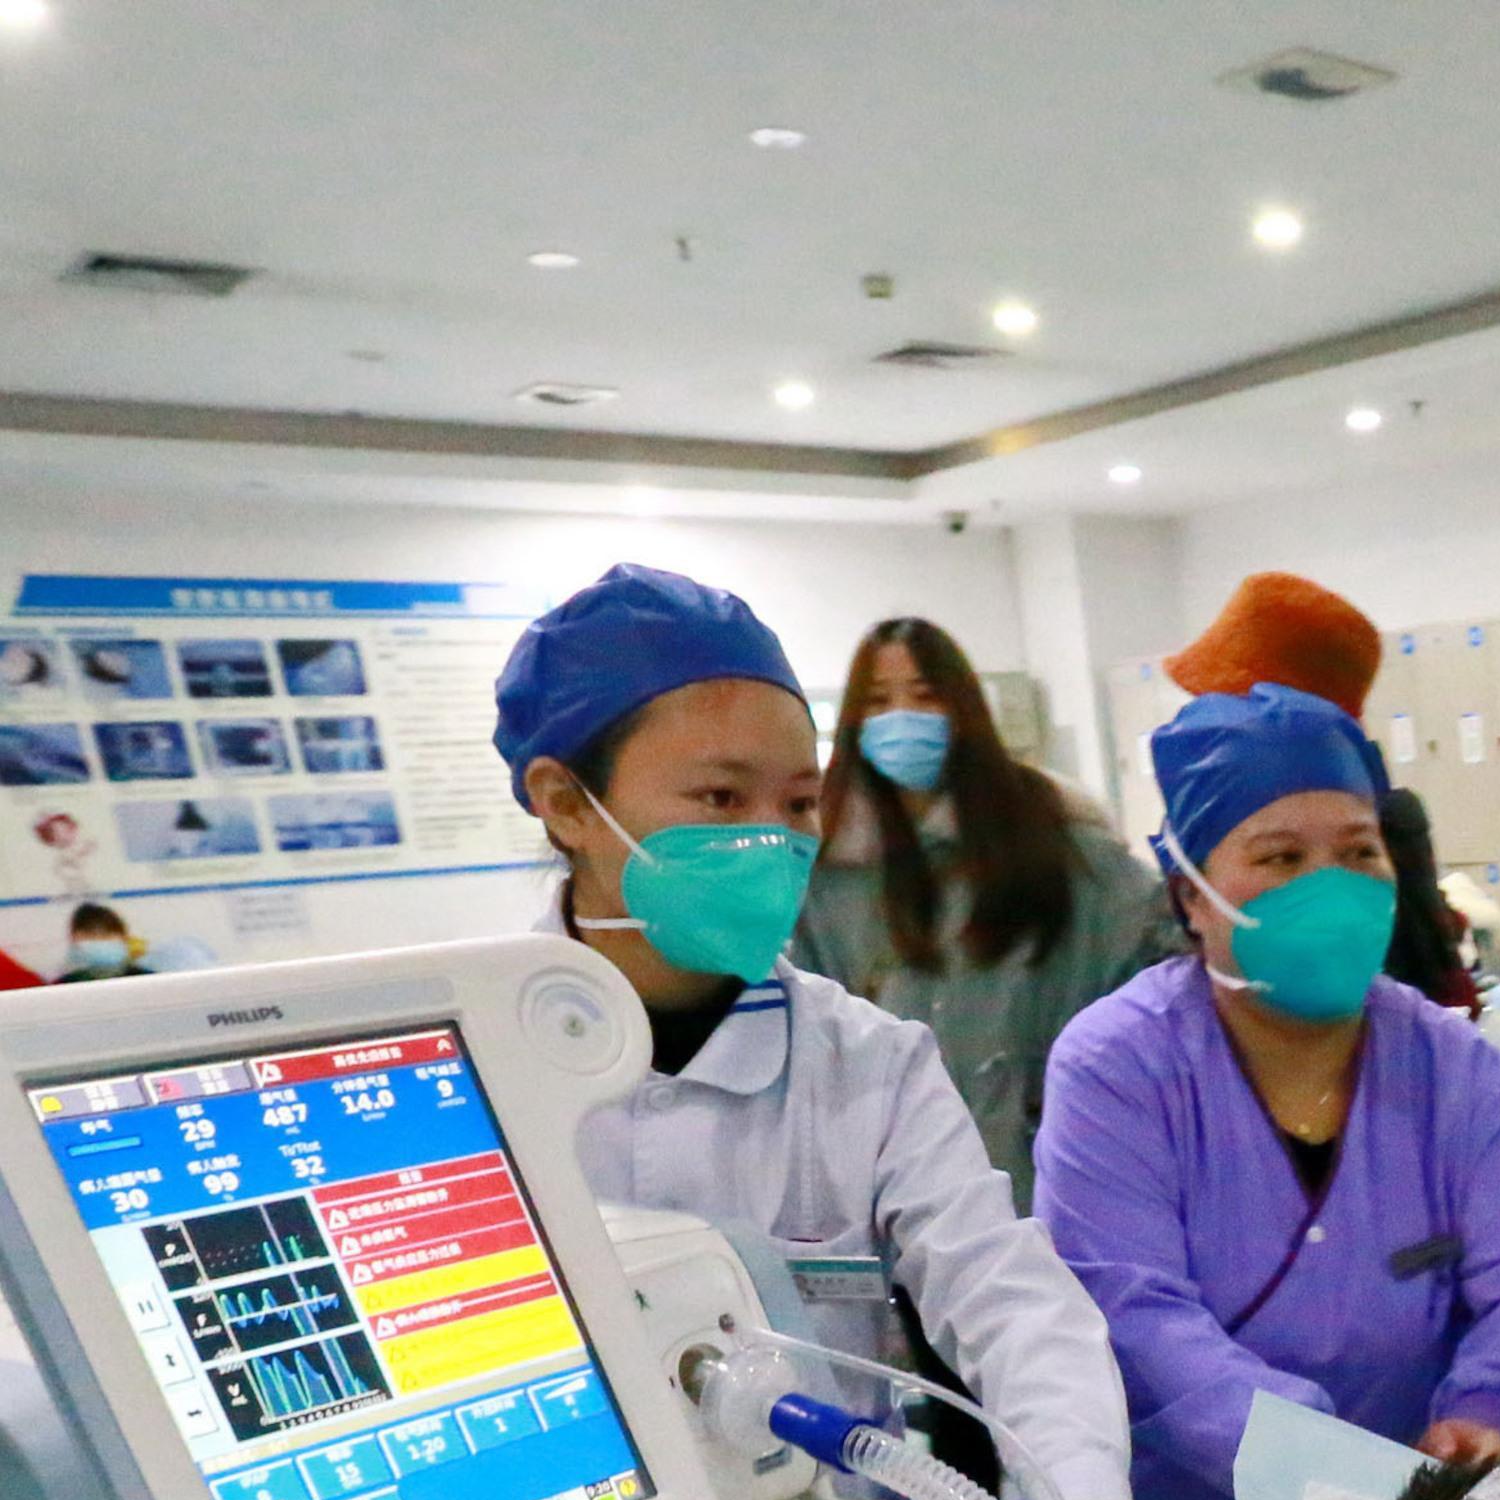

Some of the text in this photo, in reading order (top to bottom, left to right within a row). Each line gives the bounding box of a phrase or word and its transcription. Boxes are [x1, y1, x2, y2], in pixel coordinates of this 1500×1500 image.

[207, 1006, 283, 1027] PHILIPS
[437, 1079, 454, 1098] 9
[340, 1089, 395, 1115] 14.0
[263, 1103, 307, 1127] 487
[179, 1119, 216, 1142] 29
[291, 1155, 326, 1179] 32
[203, 1171, 240, 1195] 99
[110, 1188, 149, 1213] 30
